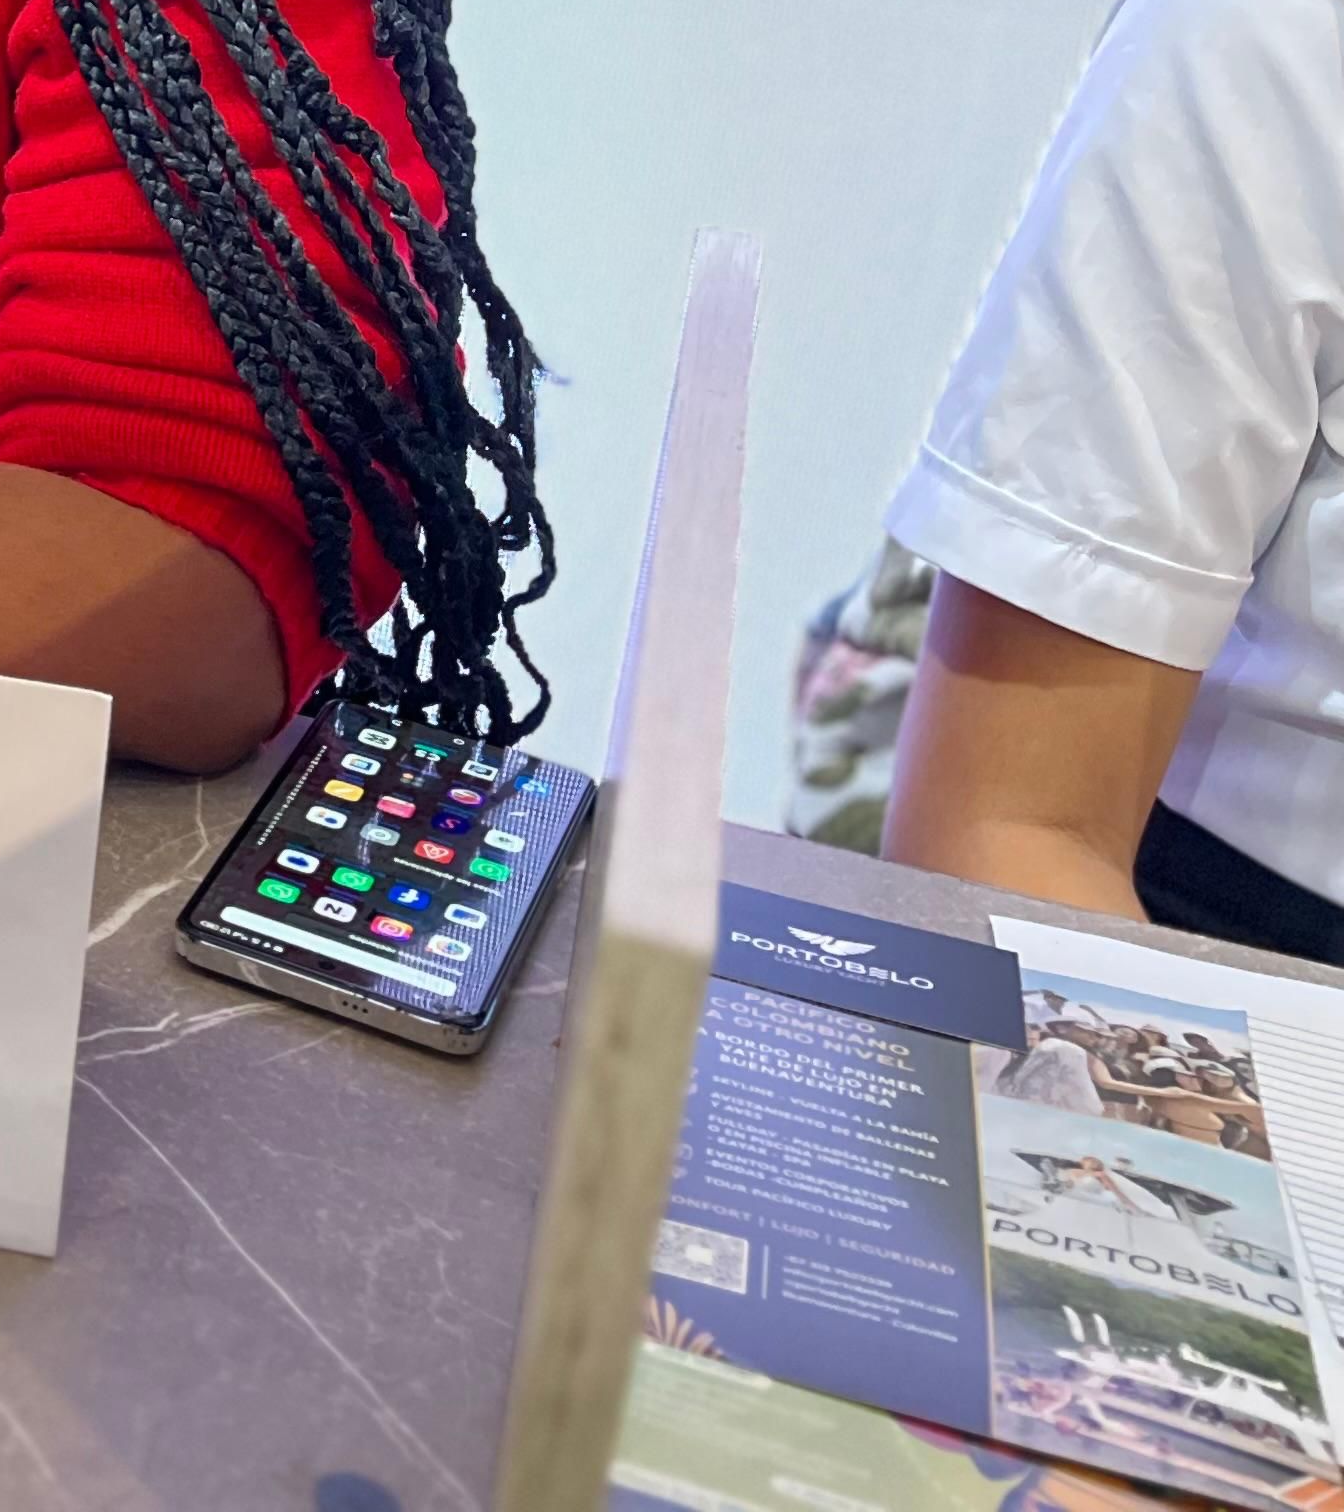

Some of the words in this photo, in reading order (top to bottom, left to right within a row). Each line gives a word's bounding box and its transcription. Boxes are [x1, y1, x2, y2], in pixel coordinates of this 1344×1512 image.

[730, 930, 935, 990] PORTOBELO
[710, 996, 911, 1056] COLOMBIANO
[733, 1015, 814, 1045] OTRO
[823, 1039, 916, 1073] NIVEL
[715, 1031, 791, 1059] BORDO
[796, 1052, 836, 1072] DEL
[841, 1065, 925, 1096] PRIMER
[719, 1053, 893, 1109] BUENAVENTURA
[720, 1043, 770, 1065] YATE
[776, 1058, 804, 1073] DE
[810, 1066, 862, 1090] LUJO
[868, 1083, 898, 1100] EN
[671, 1194, 753, 1223] ONFORT
[991, 1216, 1304, 1318] PORTOBELO
